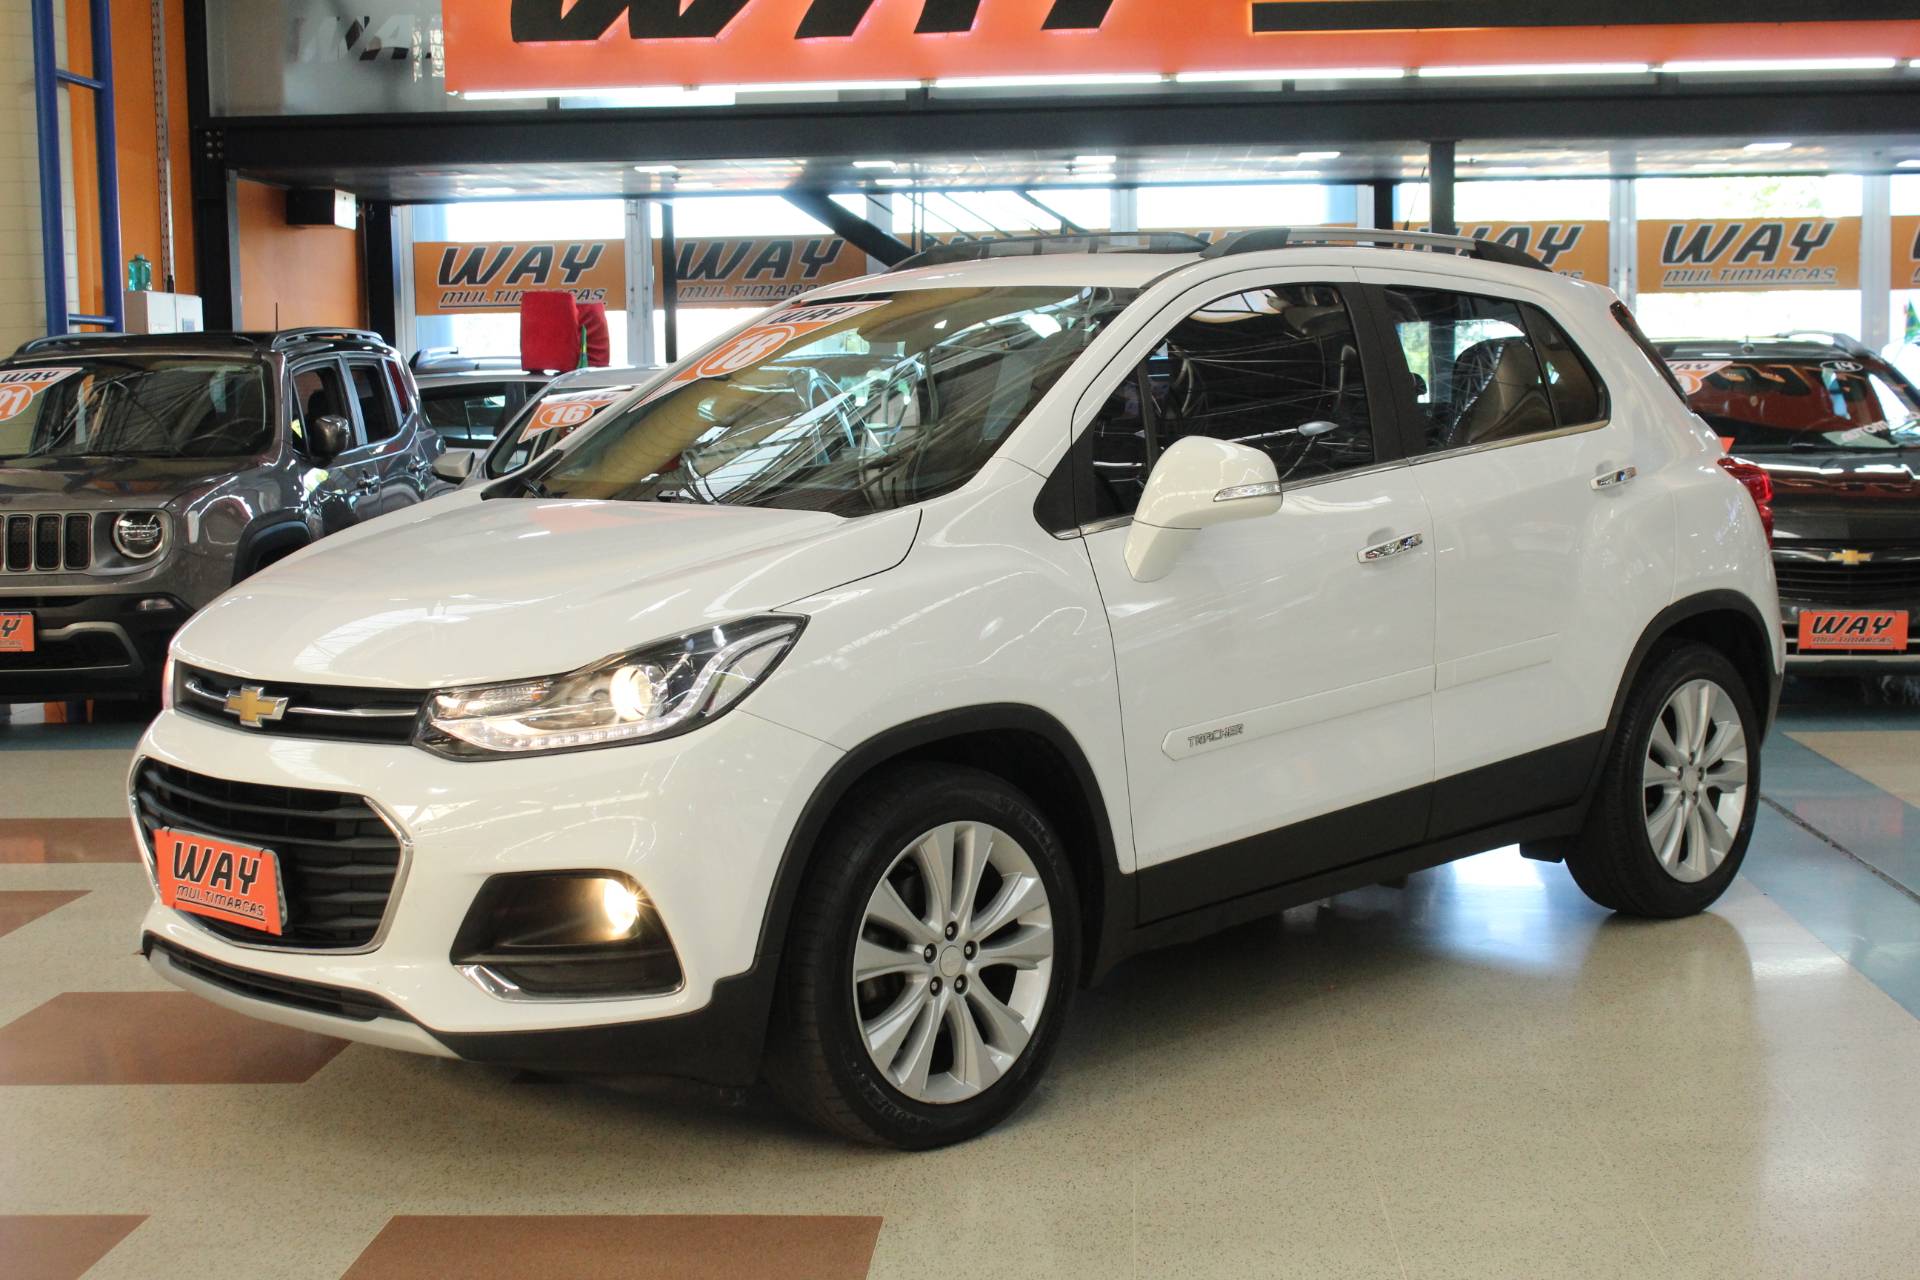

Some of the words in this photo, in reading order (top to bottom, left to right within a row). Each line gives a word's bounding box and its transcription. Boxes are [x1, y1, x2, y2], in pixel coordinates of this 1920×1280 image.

[1662, 223, 1835, 264] WAY
[438, 244, 605, 286] WAY
[676, 239, 845, 281] WAY
[1664, 268, 1836, 282] MULTIMARCAS
[768, 307, 855, 325] WAY
[706, 331, 788, 370] 18
[1, 371, 60, 383] WAY
[550, 404, 586, 424] 16
[1812, 616, 1893, 635] WAY
[173, 842, 260, 895] WAY
[176, 885, 265, 917] MULTIMARCAS
